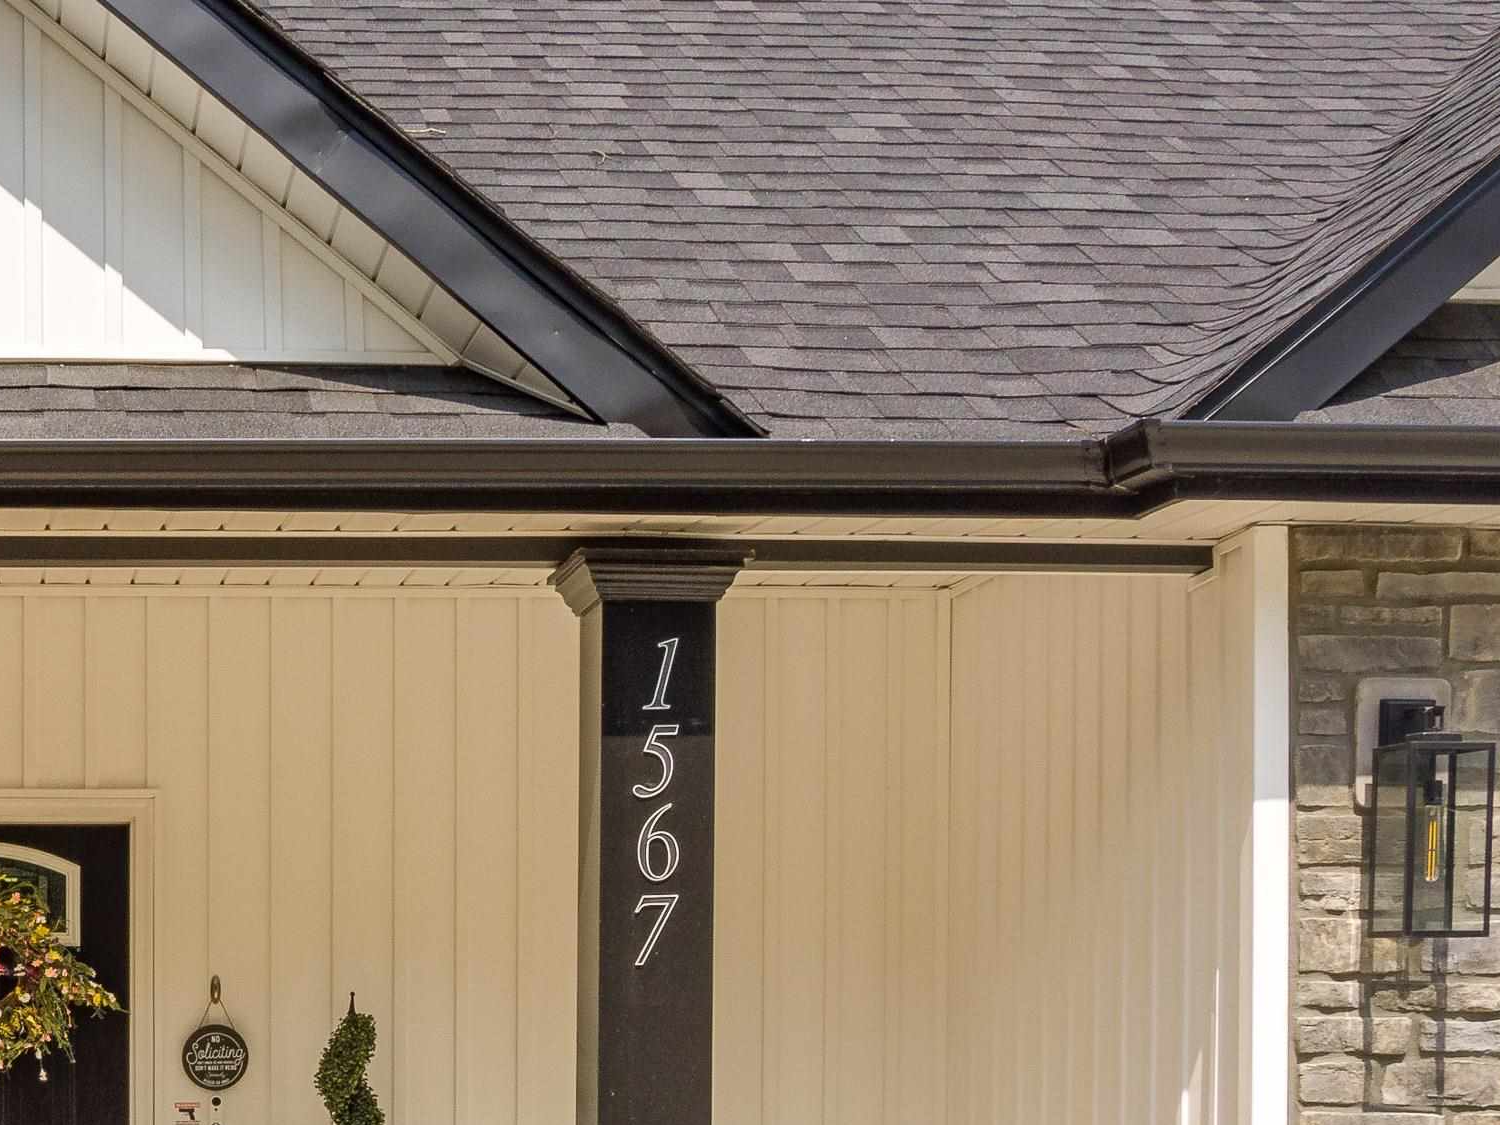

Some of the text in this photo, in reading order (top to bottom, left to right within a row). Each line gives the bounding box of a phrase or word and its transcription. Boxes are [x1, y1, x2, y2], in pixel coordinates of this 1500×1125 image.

[632, 637, 680, 967] 1567
[211, 1035, 220, 1043] NO
[186, 1042, 246, 1067] Soliciting
